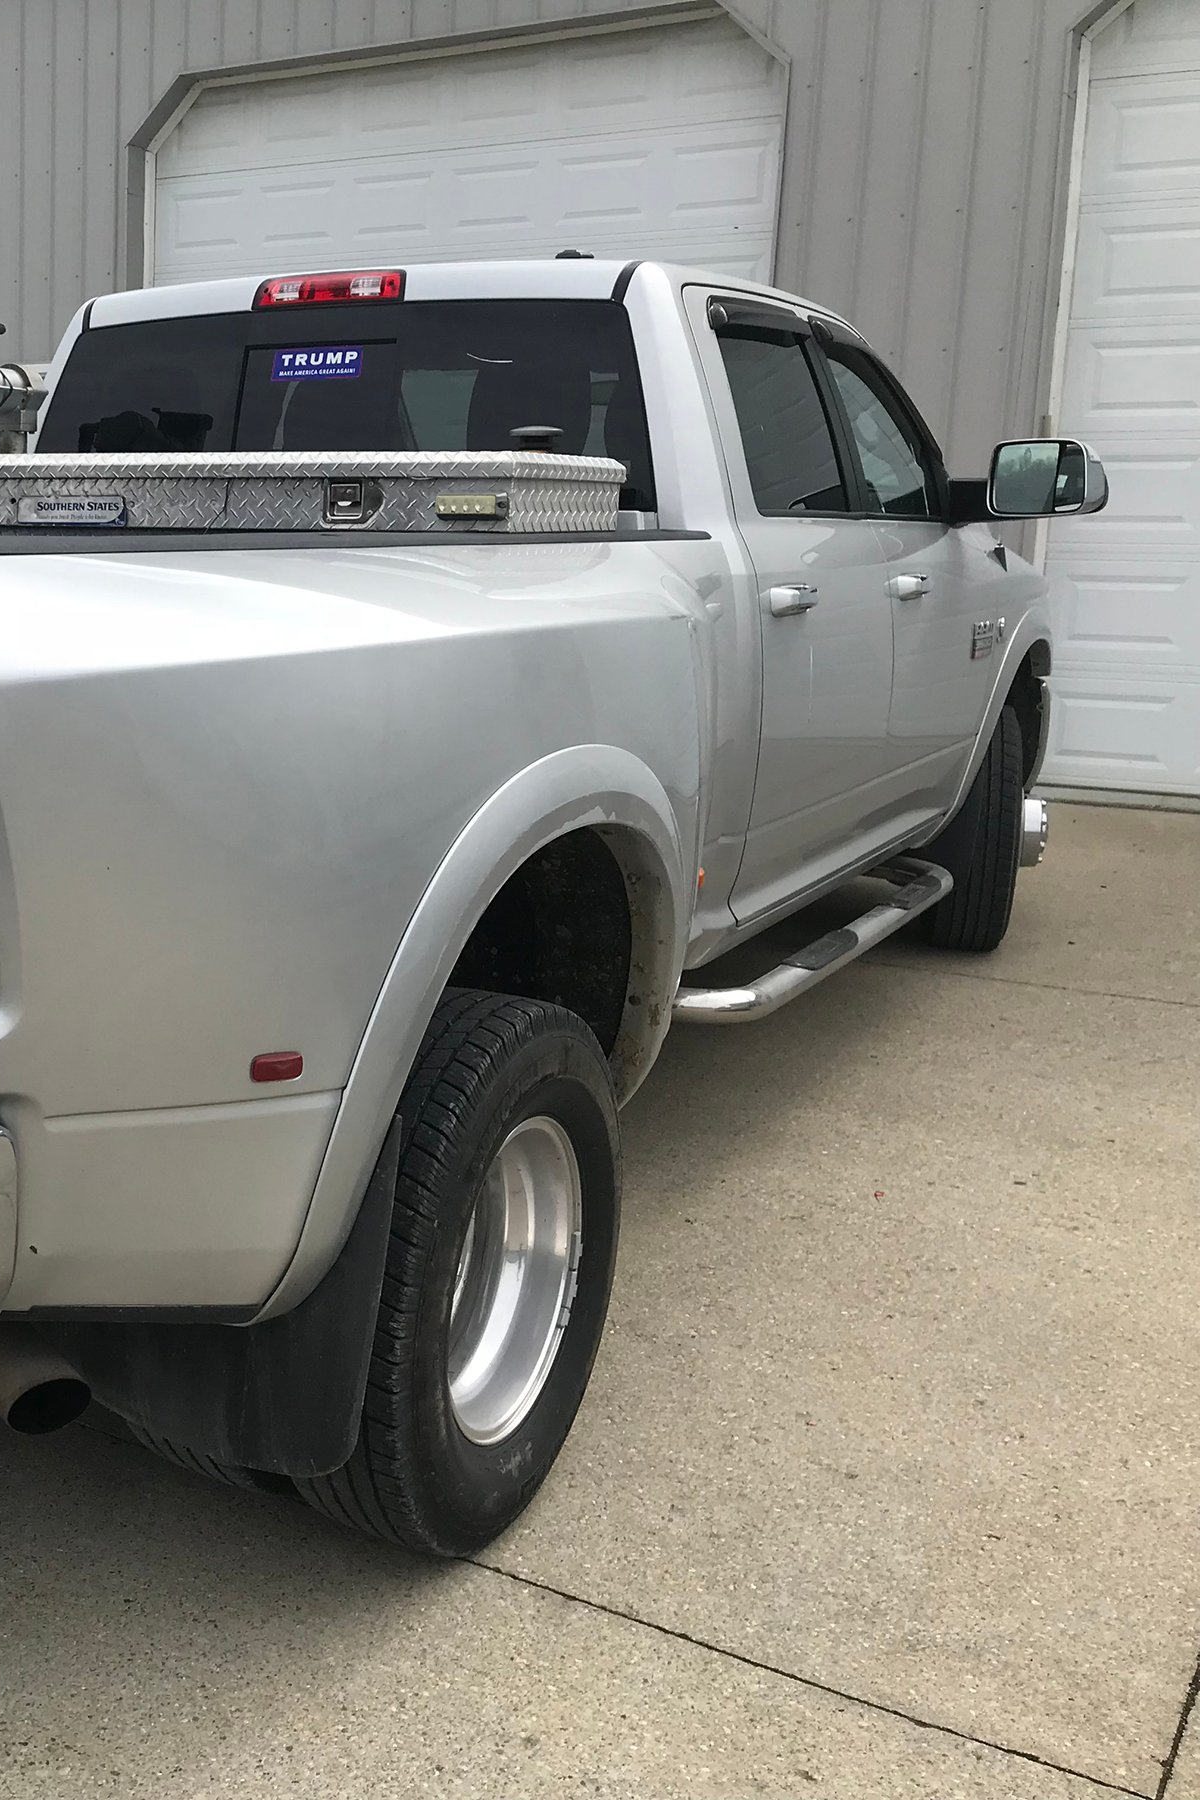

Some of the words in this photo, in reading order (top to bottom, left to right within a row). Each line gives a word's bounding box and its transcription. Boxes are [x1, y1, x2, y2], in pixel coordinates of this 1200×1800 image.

[281, 351, 358, 367] TRUMP
[36, 501, 86, 512] SOUTHERN
[87, 501, 120, 512] STATES
